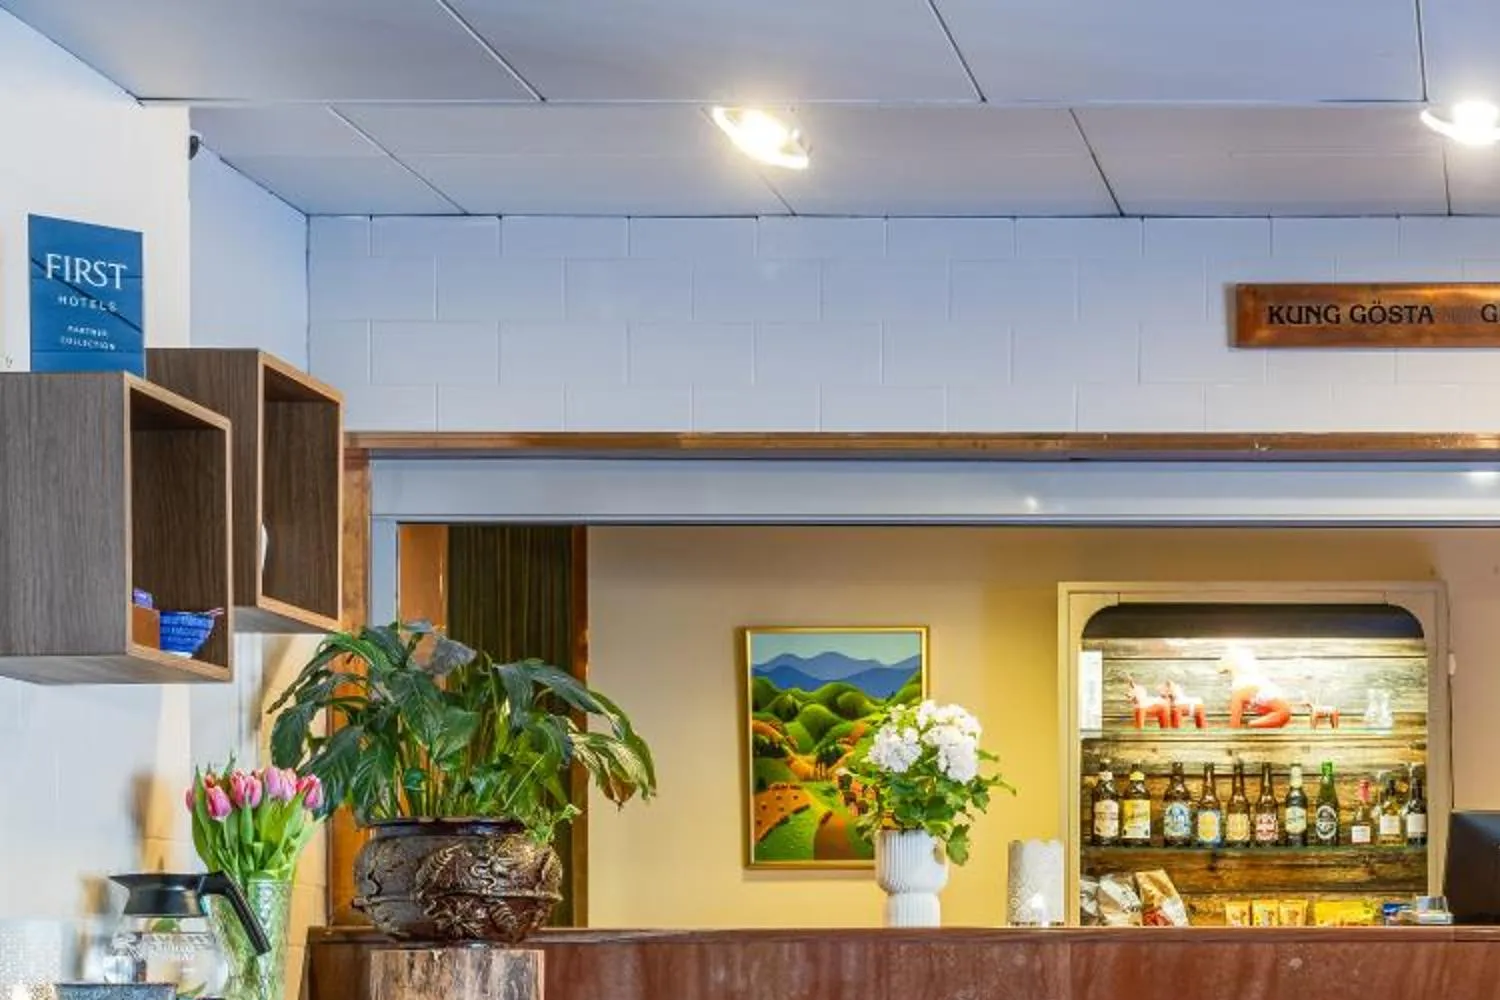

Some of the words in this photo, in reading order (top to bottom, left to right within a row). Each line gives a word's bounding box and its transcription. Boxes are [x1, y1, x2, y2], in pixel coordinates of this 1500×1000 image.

[46, 253, 128, 289] FIRST
[57, 295, 118, 312] HOTELS
[1267, 304, 1341, 325] KUNG
[1349, 300, 1436, 325] GÖSTA
